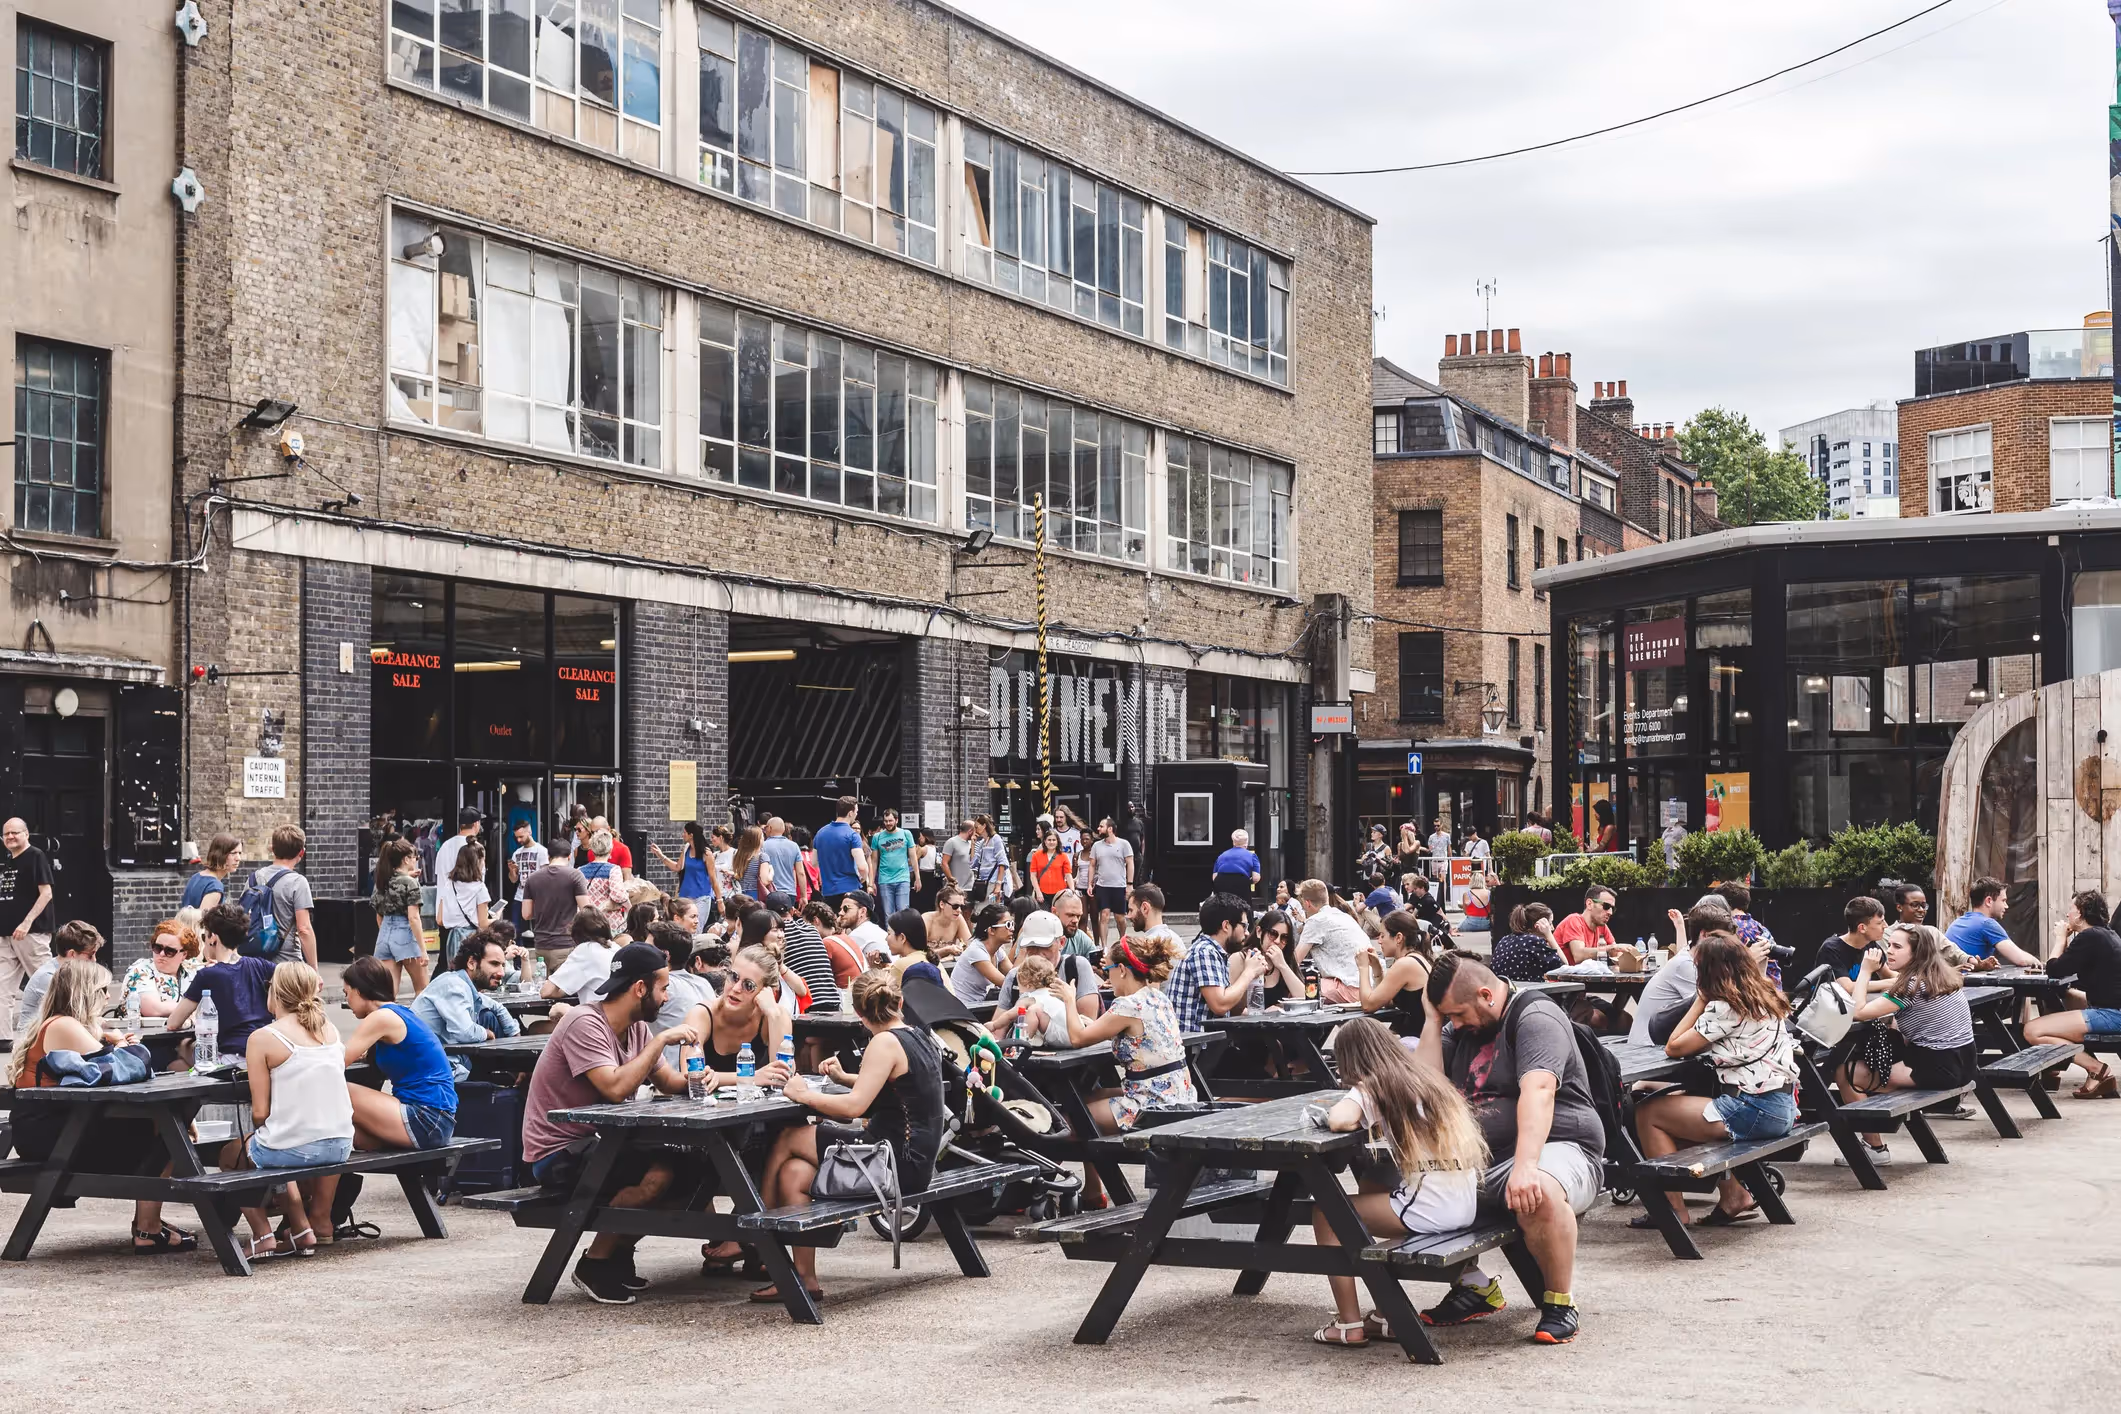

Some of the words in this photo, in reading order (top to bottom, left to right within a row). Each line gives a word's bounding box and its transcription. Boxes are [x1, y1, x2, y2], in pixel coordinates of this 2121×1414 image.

[1630, 632, 1643, 642] THE
[371, 651, 441, 669] CLEARANCE
[1630, 649, 1667, 662] BREWERY
[392, 673, 421, 688] SALE
[558, 666, 617, 684] CLEARANCE
[575, 687, 600, 701] SALE
[1623, 711, 1641, 720] Events
[1642, 707, 1673, 720] Department
[489, 723, 512, 736] Outlet
[1634, 722, 1648, 732] 7770
[1648, 720, 1661, 731] 6100
[1623, 732, 1686, 744] events@trumanbrewery.com
[250, 761, 280, 771] CAUTION
[247, 773, 283, 784] INTERNAL
[601, 774, 615, 785] Shop
[251, 785, 280, 795] TRAFFIC
